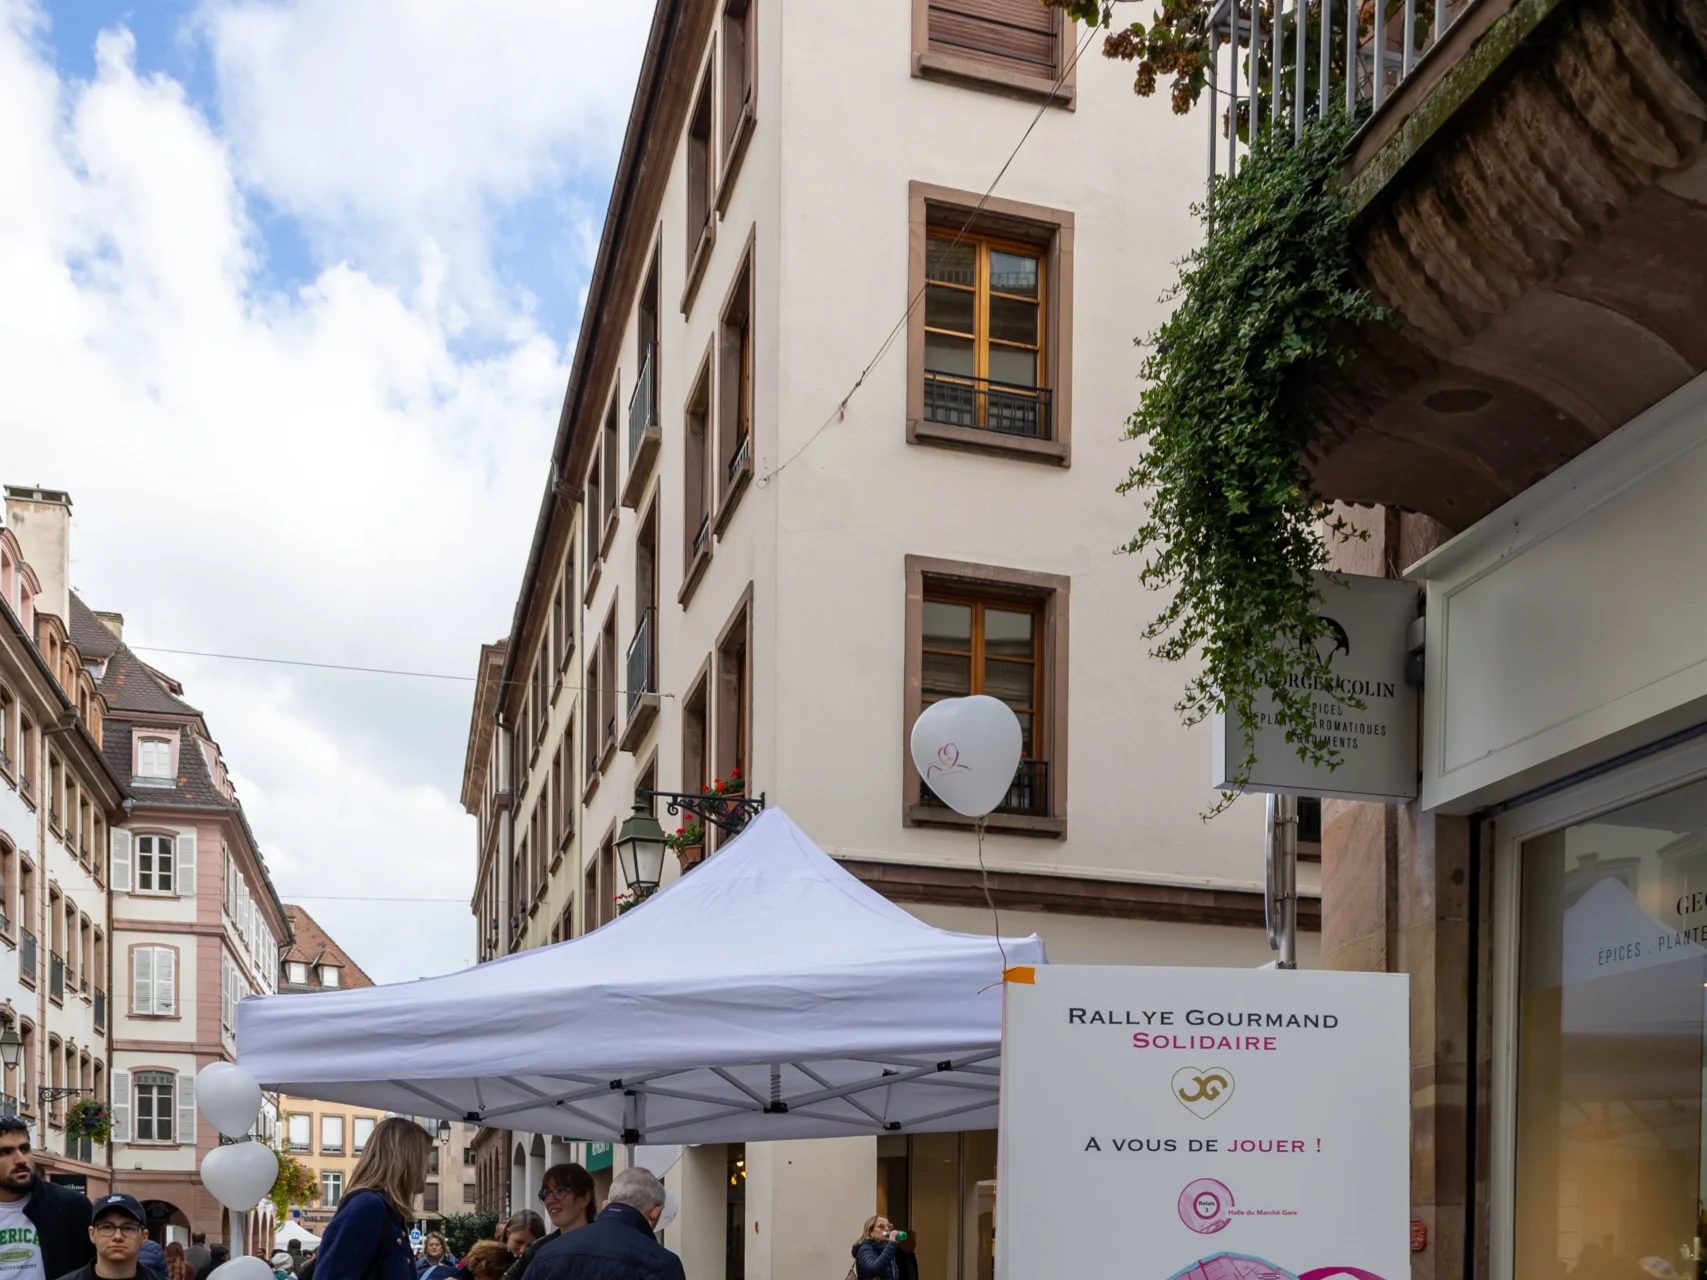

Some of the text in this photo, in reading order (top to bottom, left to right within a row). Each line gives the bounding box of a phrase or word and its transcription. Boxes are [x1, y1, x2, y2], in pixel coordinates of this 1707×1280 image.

[1251, 669, 1395, 698] GRGES COLIN
[1306, 702, 1343, 716] PICES
[1312, 719, 1386, 736] AROMATIQUES
[1290, 733, 1358, 749] ONDIMENTS
[1676, 892, 1707, 916] GE
[1598, 941, 1641, 966] ÉPICES
[1069, 1008, 1338, 1029] RALLYE GOURMAND
[1133, 1032, 1277, 1051] SOLIDAIRE
[1084, 1136, 1321, 1153] A VOUS DE JOUER !
